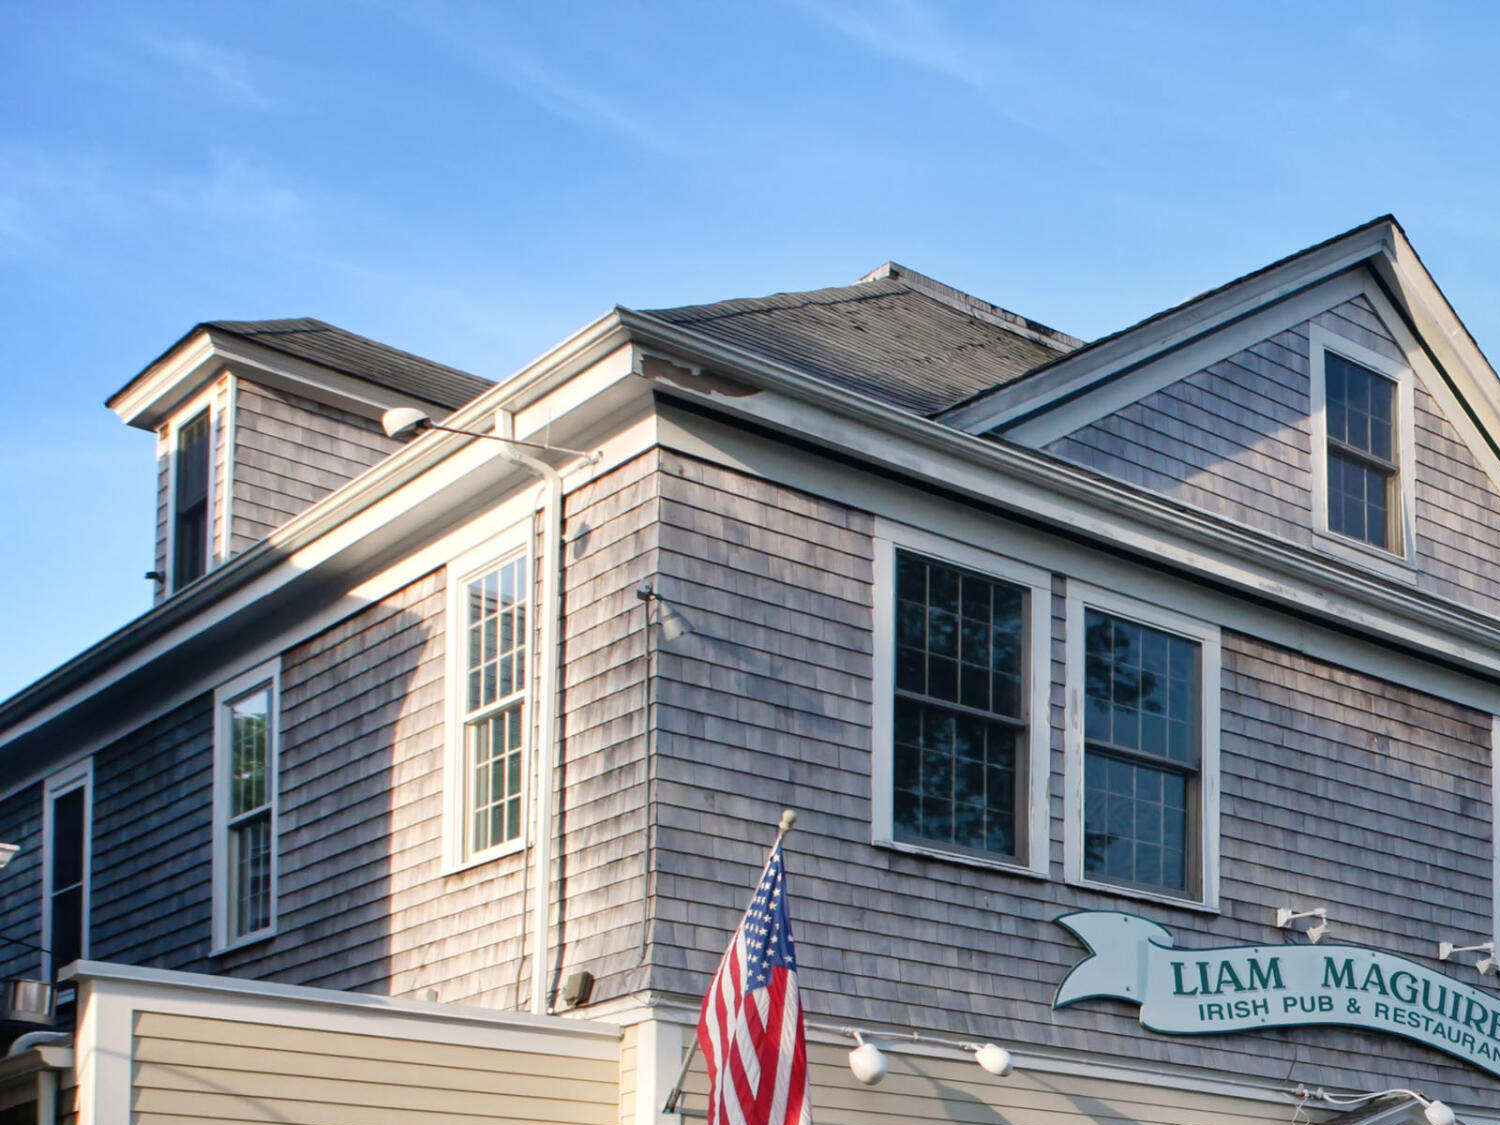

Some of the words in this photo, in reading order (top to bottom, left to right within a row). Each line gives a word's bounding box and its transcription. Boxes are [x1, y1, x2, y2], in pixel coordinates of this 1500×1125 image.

[1170, 956, 1286, 996] LIAM
[1198, 998, 1270, 1022] IRISH
[1283, 994, 1334, 1013] PUB
[1346, 998, 1362, 1015] &
